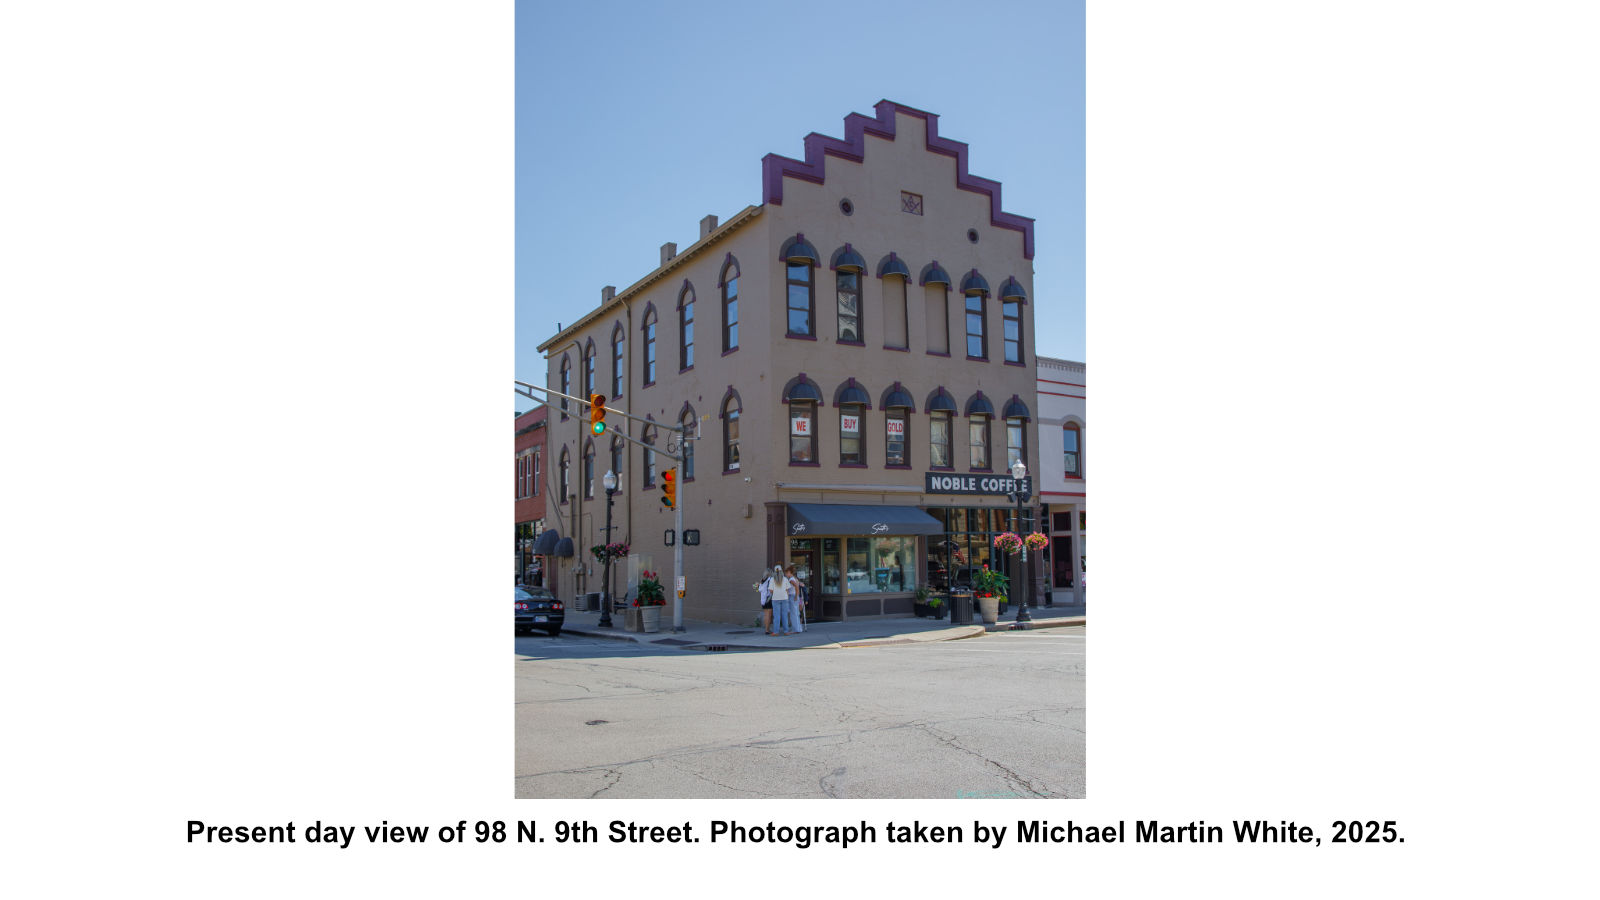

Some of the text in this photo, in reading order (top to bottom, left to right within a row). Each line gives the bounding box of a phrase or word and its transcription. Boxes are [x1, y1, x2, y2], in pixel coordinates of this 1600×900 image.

[796, 418, 903, 433] WE BUY GOLD
[931, 476, 976, 491] NOBLE
